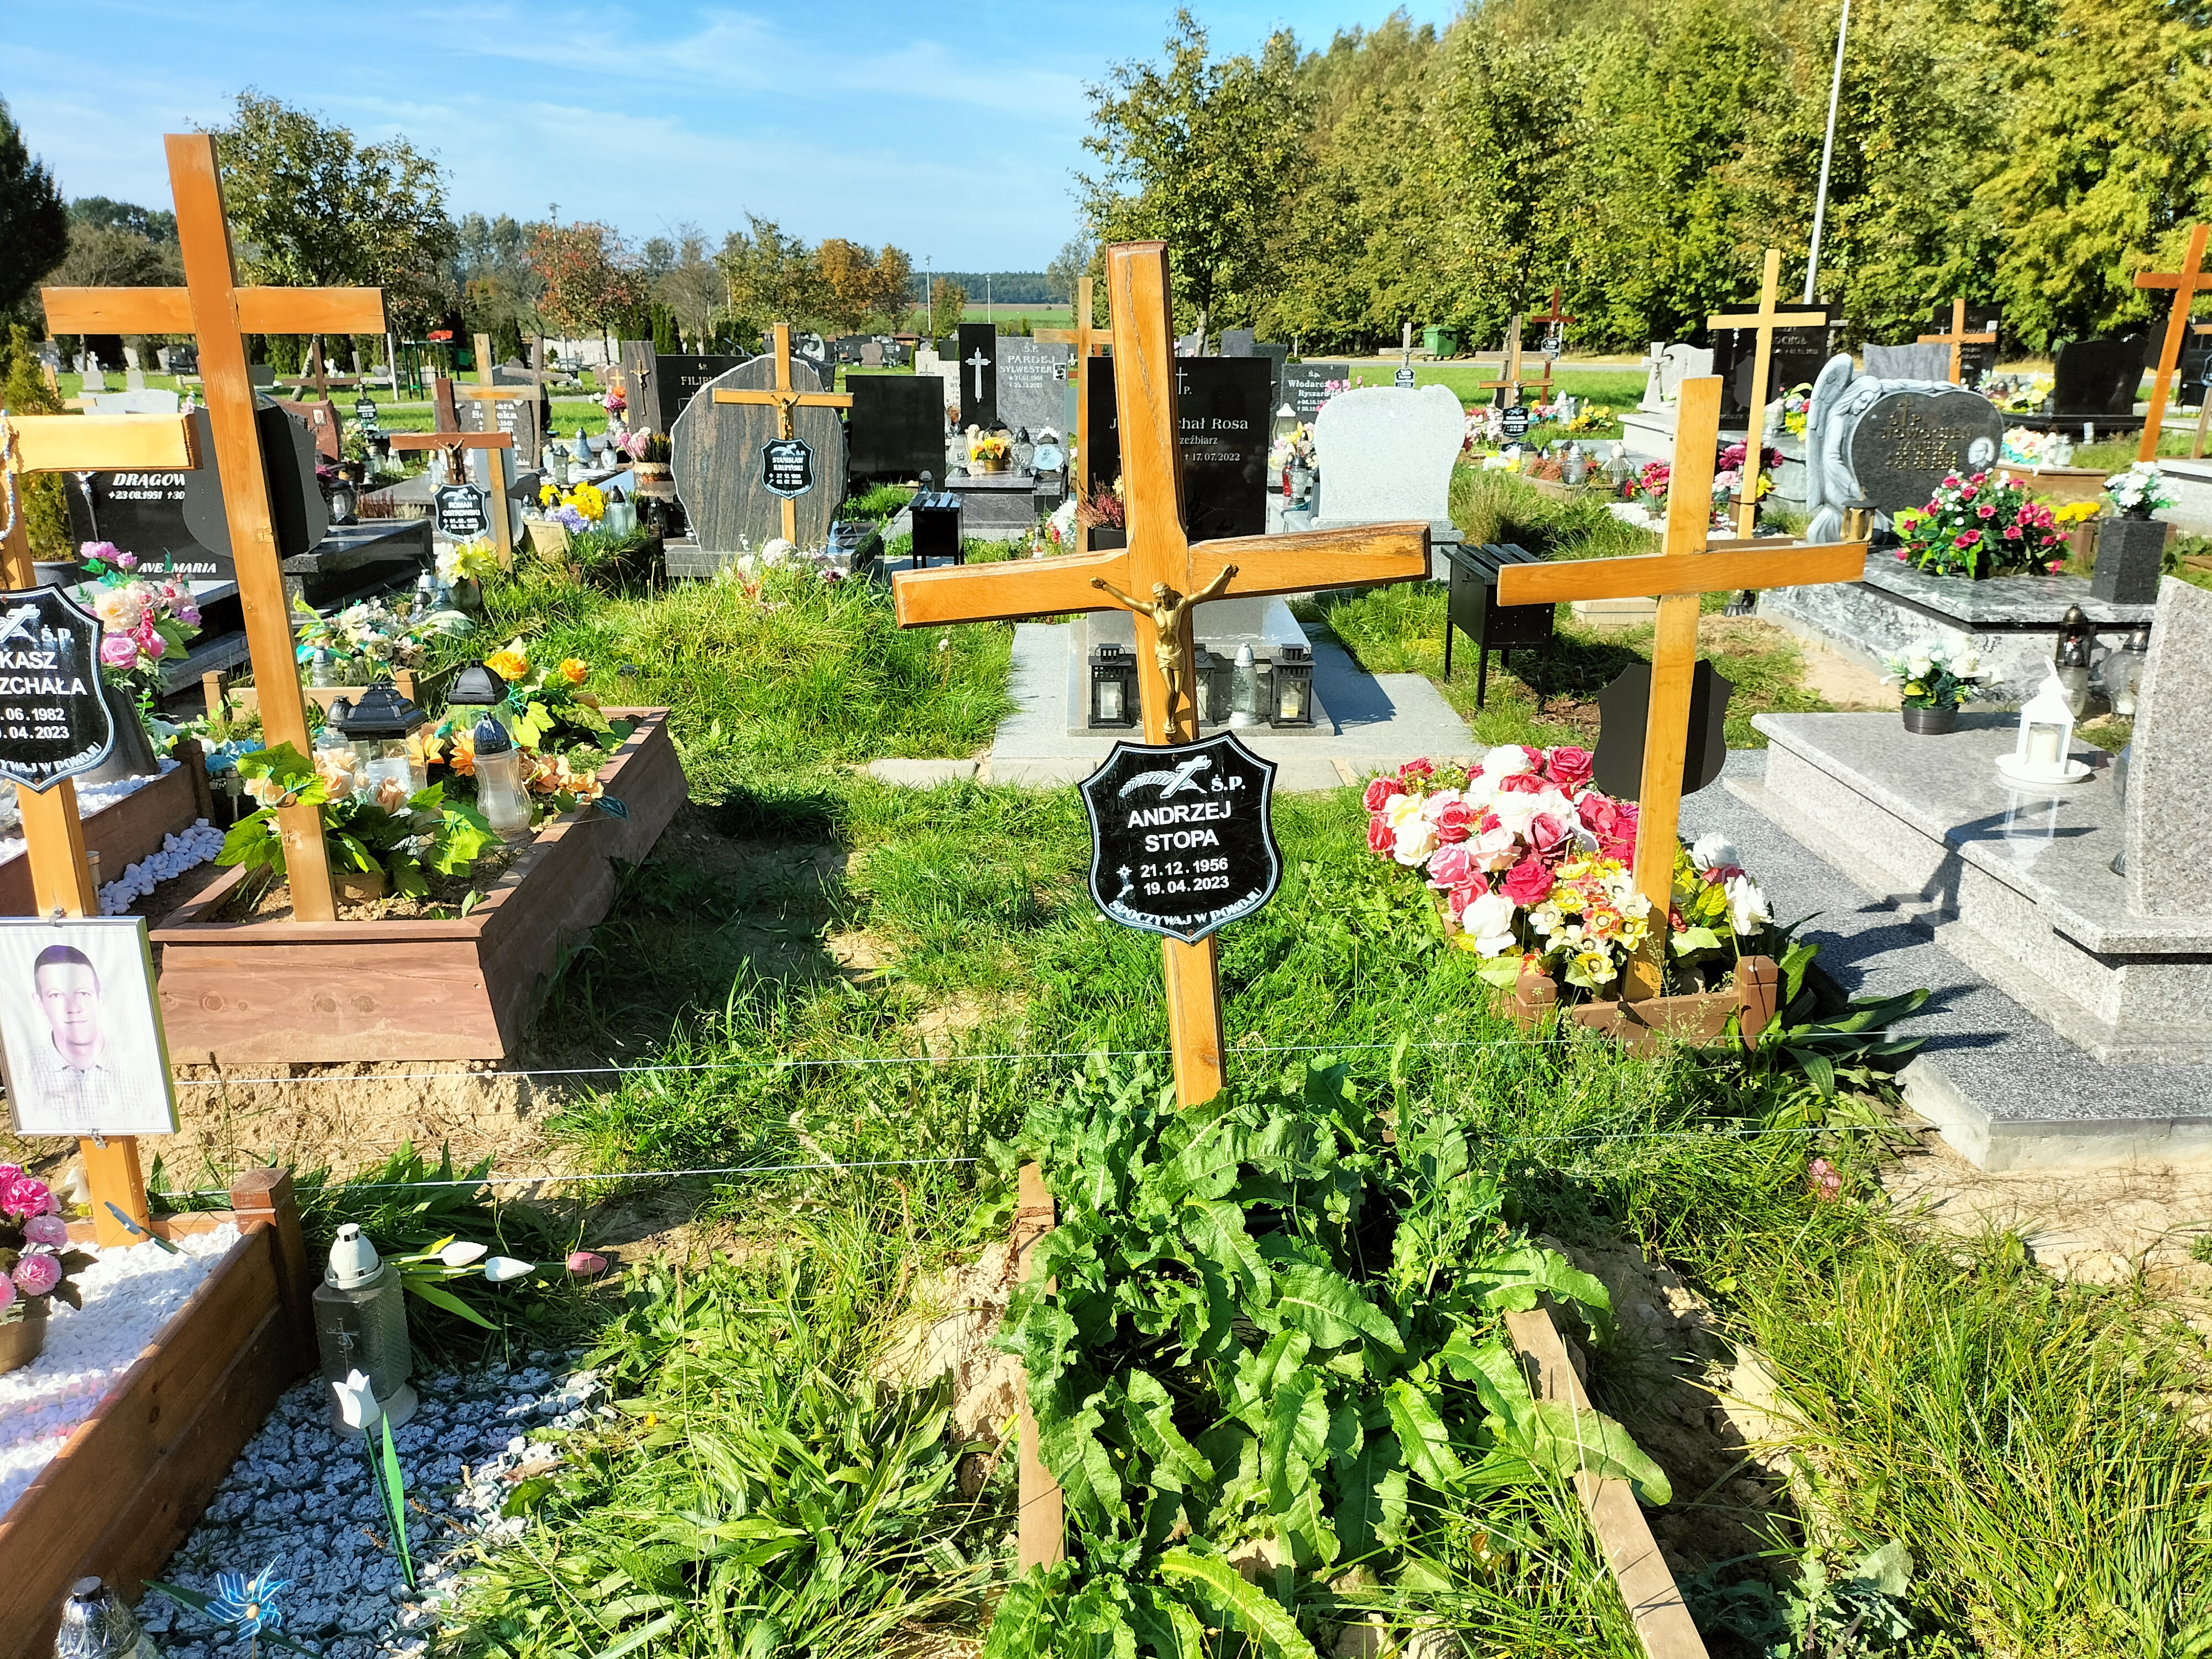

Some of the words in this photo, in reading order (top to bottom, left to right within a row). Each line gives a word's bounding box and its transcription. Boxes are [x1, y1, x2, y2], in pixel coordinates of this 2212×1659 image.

[1008, 355, 1055, 363] PARDEJ
[680, 376, 713, 385] FILIP
[1211, 418, 1249, 430] Rosa
[1192, 452, 1240, 461] 17.07.2022
[137, 562, 165, 573] AVE
[170, 562, 217, 573] MARIA
[0, 651, 58, 669] KASZ
[38, 761, 52, 773] W
[53, 742, 102, 771] POKOJU
[1211, 774, 1246, 792] Ś.P.
[1127, 801, 1232, 829] ANDRZEJ
[1145, 829, 1220, 852] STOPA
[1140, 857, 1228, 878] 21.12.1956
[1144, 875, 1229, 896] 19.04.2023
[1108, 900, 1192, 926] SPOCZYWAJ
[1194, 912, 1208, 924] W
[1209, 887, 1262, 924] POKOJU
